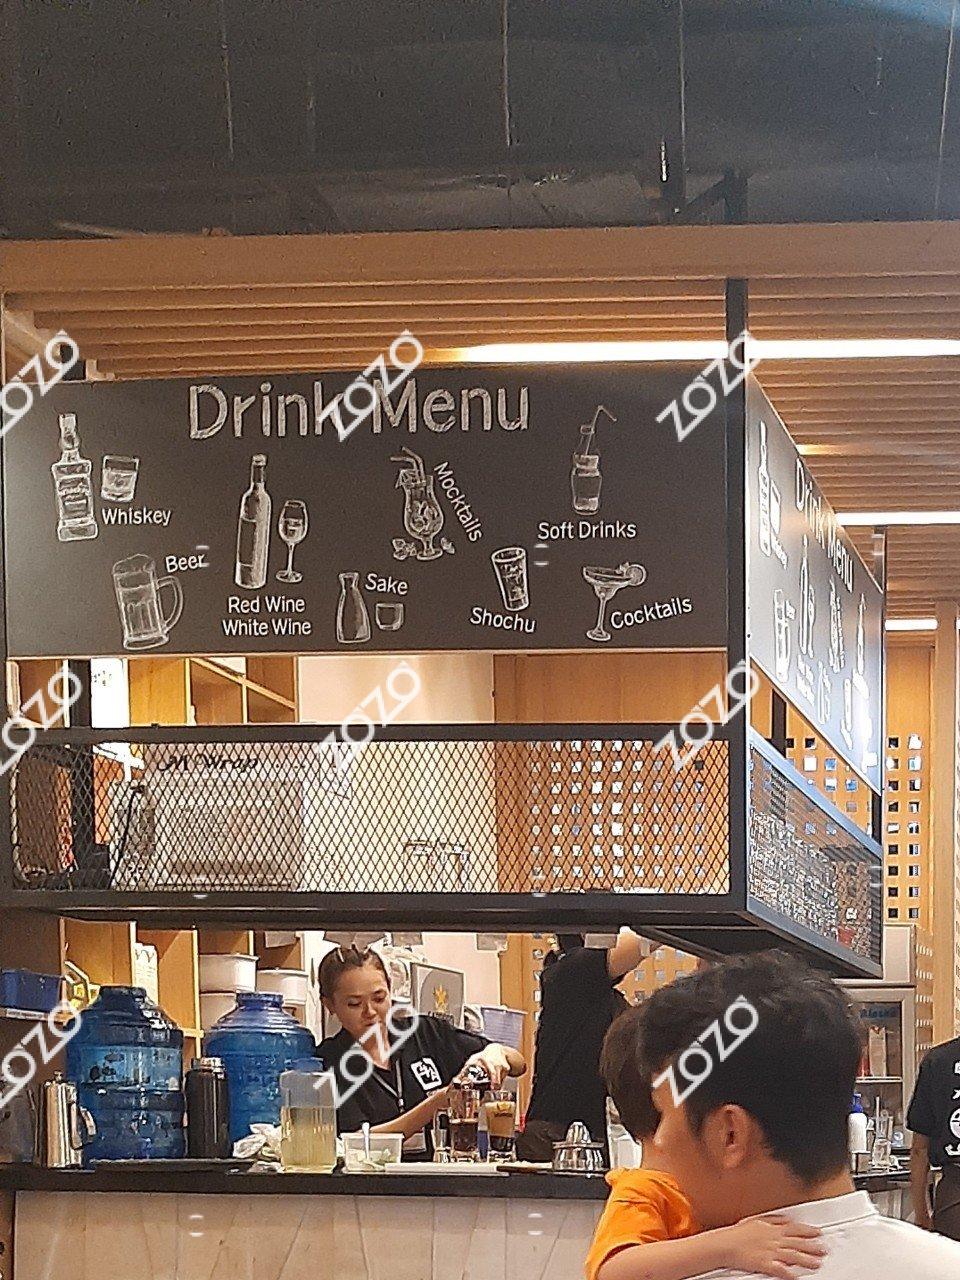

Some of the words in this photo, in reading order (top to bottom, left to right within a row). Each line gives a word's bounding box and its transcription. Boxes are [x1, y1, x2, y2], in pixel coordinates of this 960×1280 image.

[189, 381, 346, 440] Drink
[373, 378, 529, 434] Menu
[434, 462, 483, 542] Mocktails
[101, 507, 171, 527] Whiskey
[538, 522, 573, 540] Soft
[579, 520, 636, 539] Drinks
[165, 553, 205, 573] Beer
[365, 573, 408, 595] Sake
[228, 596, 260, 614] Red
[265, 596, 305, 613] Wine
[611, 597, 692, 631] Cocktails
[222, 620, 268, 636] White
[271, 619, 312, 636] Wine
[470, 607, 536, 633] Shochu
